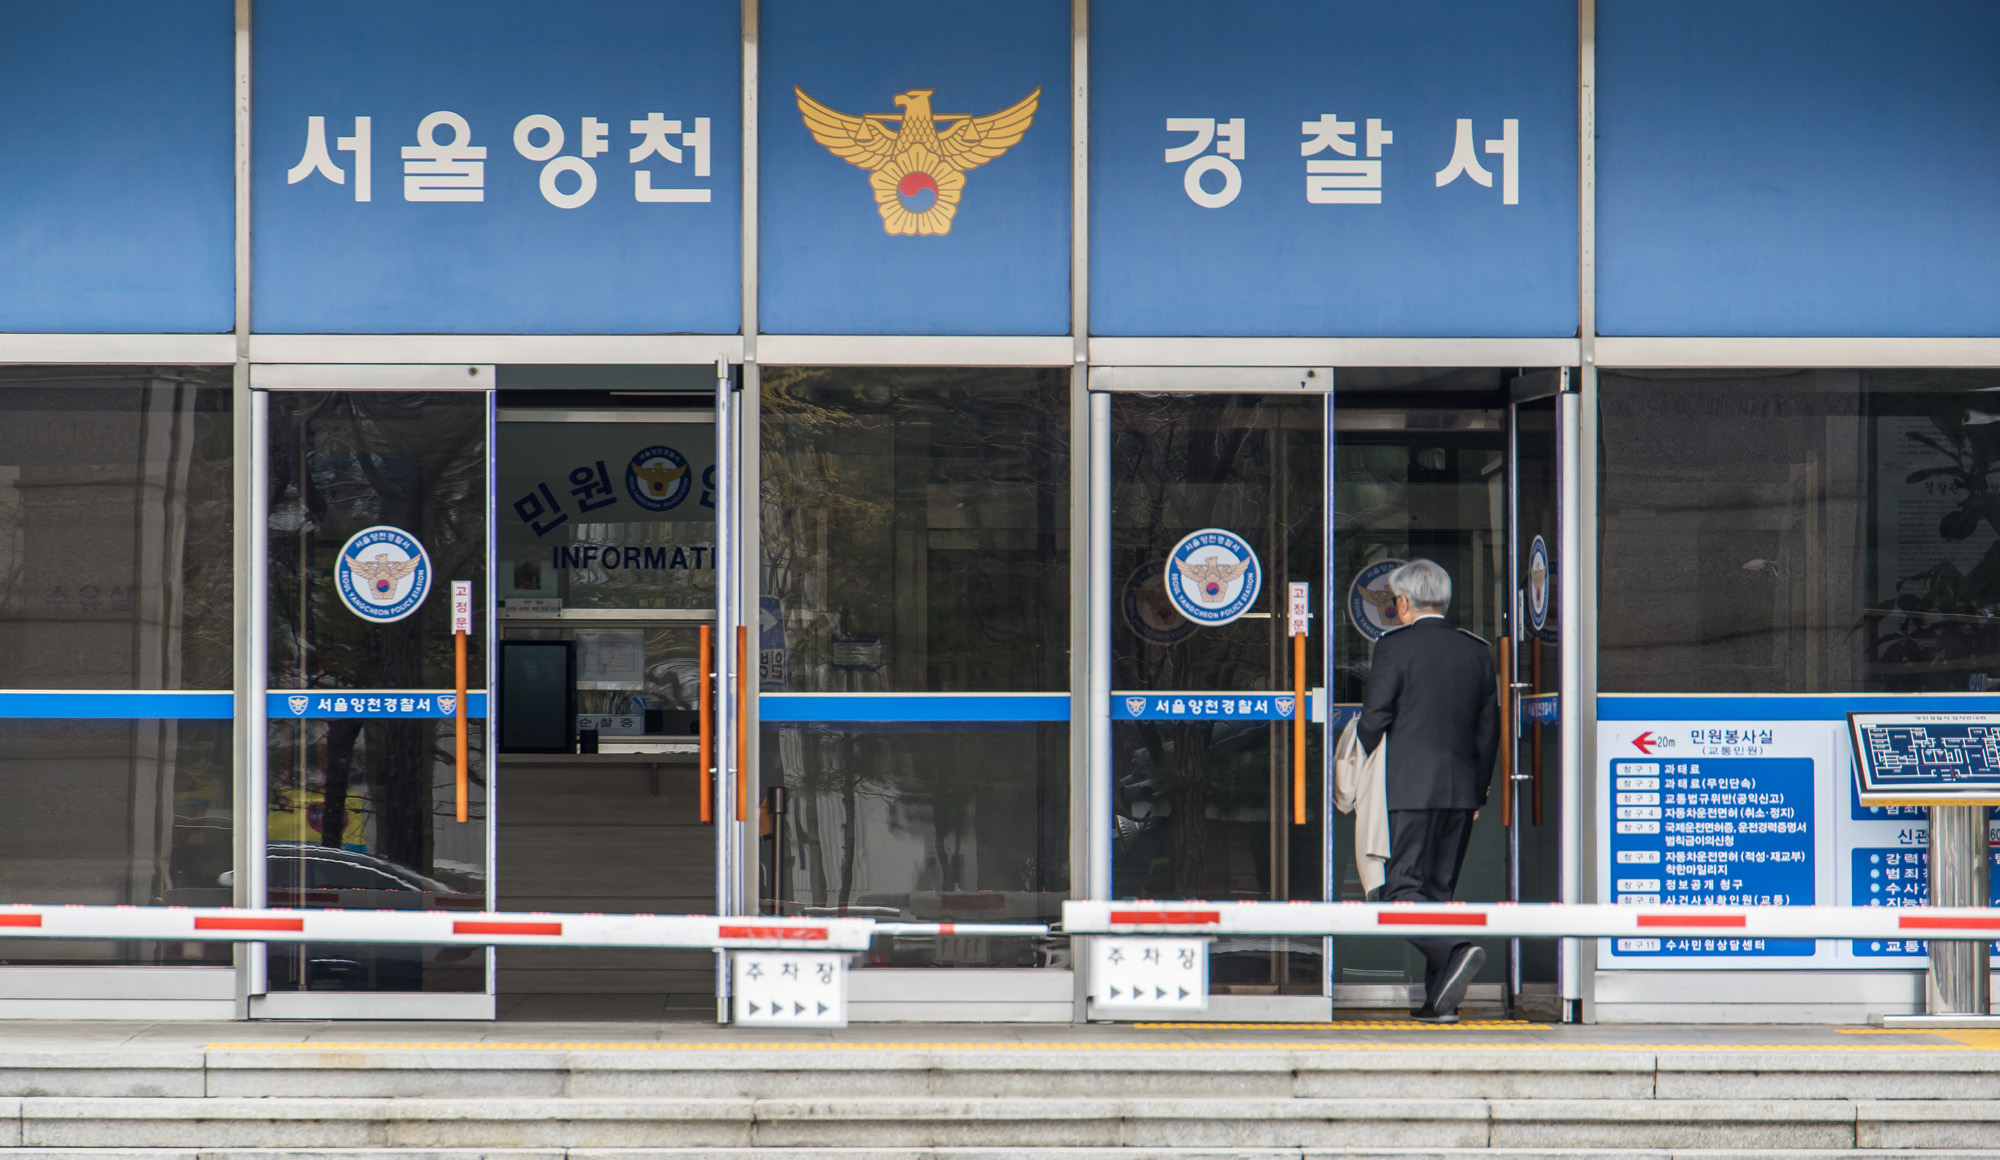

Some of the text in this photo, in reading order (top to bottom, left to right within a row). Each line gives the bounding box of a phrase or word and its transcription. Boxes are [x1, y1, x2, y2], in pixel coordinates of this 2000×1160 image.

[287, 110, 1519, 209] 서울양천 경찰서
[513, 460, 618, 537] 민원
[355, 532, 411, 550] 서울양천경찰서
[1185, 535, 1241, 552] 서울양천경찰서
[342, 570, 424, 616] SEOUL YANGCHEON POLICE STATION
[1172, 572, 1254, 618] SEOUL YANGCHEON POLICE STATION
[455, 586, 468, 630] 고정문
[1293, 588, 1305, 631] 고정문
[317, 698, 431, 712] 서울양천경찰서
[1155, 698, 1268, 714] 서울양천경찰서
[1657, 736, 1676, 748] 20m
[1690, 729, 1773, 745] 민원봉사실
[1702, 746, 1764, 756] (교통민원)
[1664, 764, 1700, 774] 과태료
[1664, 778, 1756, 790] 과태료(무인단속)
[1664, 792, 1784, 804] 교통법규위반(공익신고)
[1664, 807, 1738, 818] 자동차운전면허
[1665, 822, 1736, 834] 국제운전면허증,
[1738, 822, 1806, 833] 운전경력증명서
[1665, 836, 1734, 847] 범칙금이의신청
[1666, 851, 1738, 862] 자동차운전면허
[1666, 864, 1728, 876] 착한마일리지
[1666, 879, 1714, 890] 정보공개
[1720, 879, 1744, 890] 청구
[1666, 939, 1766, 951] 수사민원상담센터
[1108, 947, 1196, 970] 주차장
[746, 961, 834, 985] 주차장
